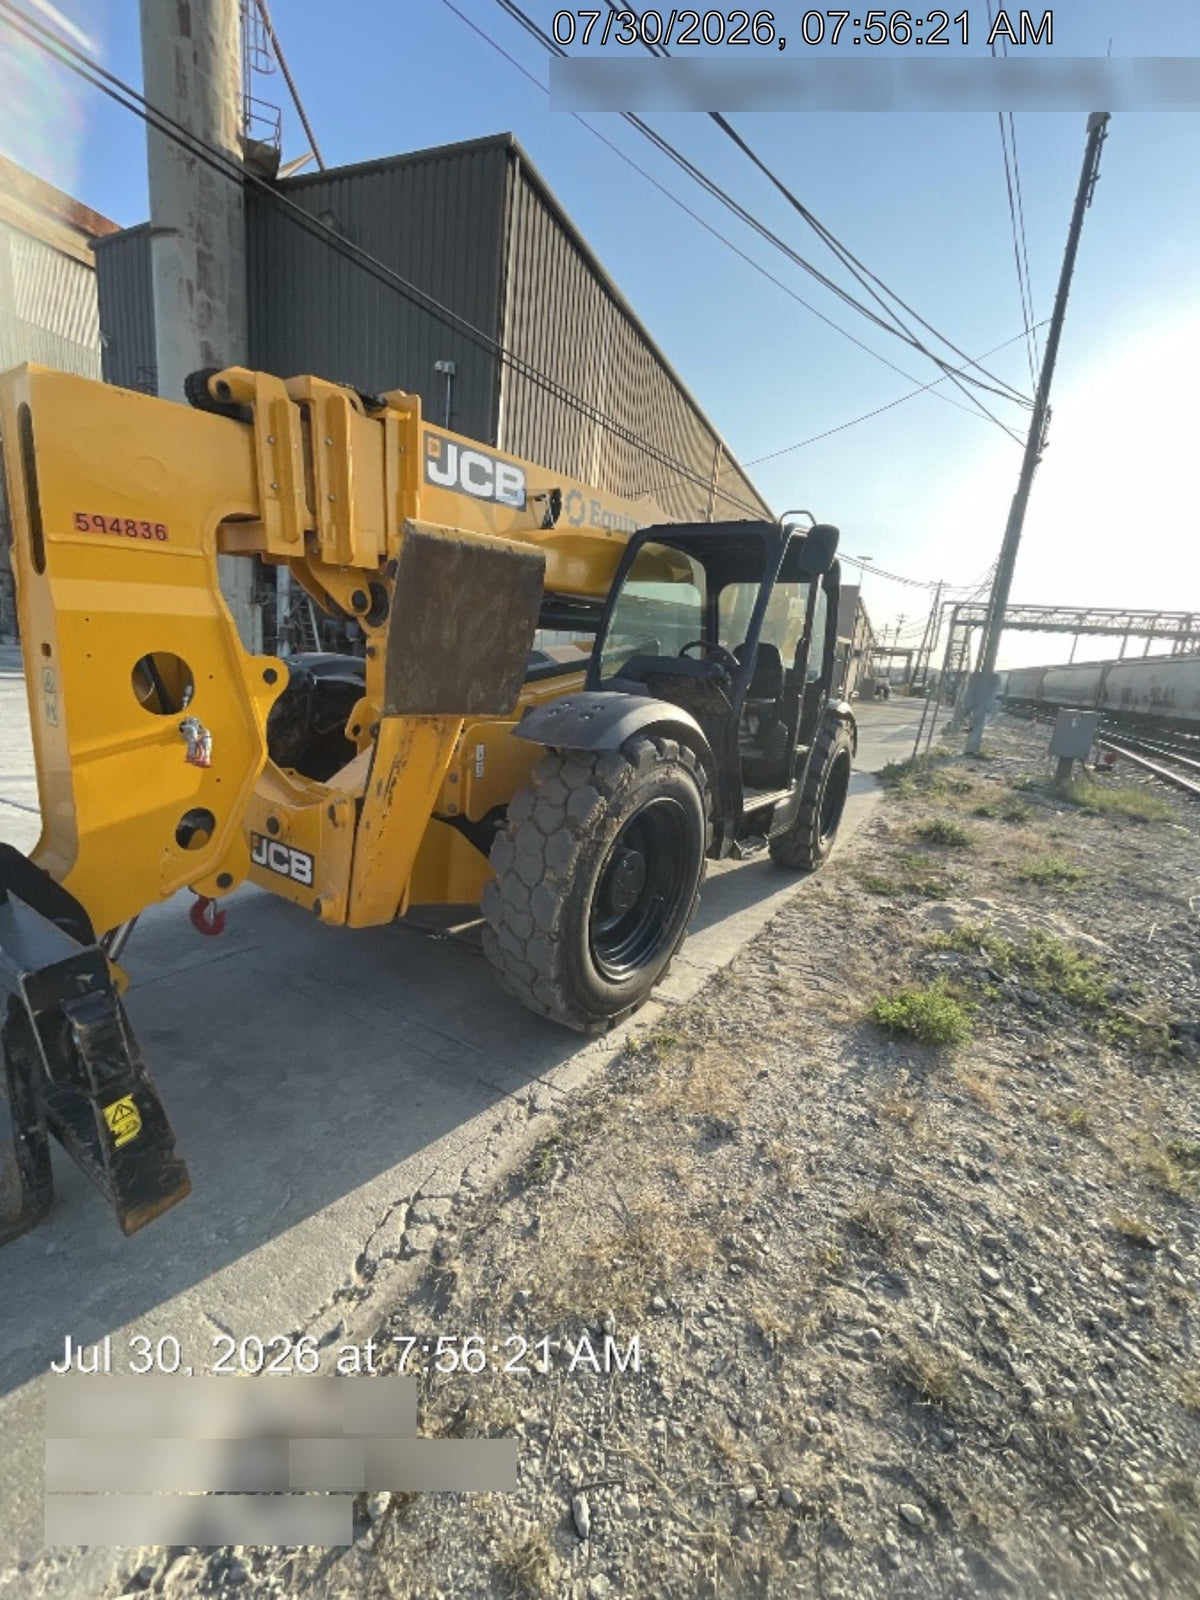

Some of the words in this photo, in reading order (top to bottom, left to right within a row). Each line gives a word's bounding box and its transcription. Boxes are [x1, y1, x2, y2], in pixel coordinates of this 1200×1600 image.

[427, 443, 525, 506] JCB
[76, 512, 168, 541] 594836
[590, 498, 640, 538] Equip
[252, 838, 312, 885] JCB
